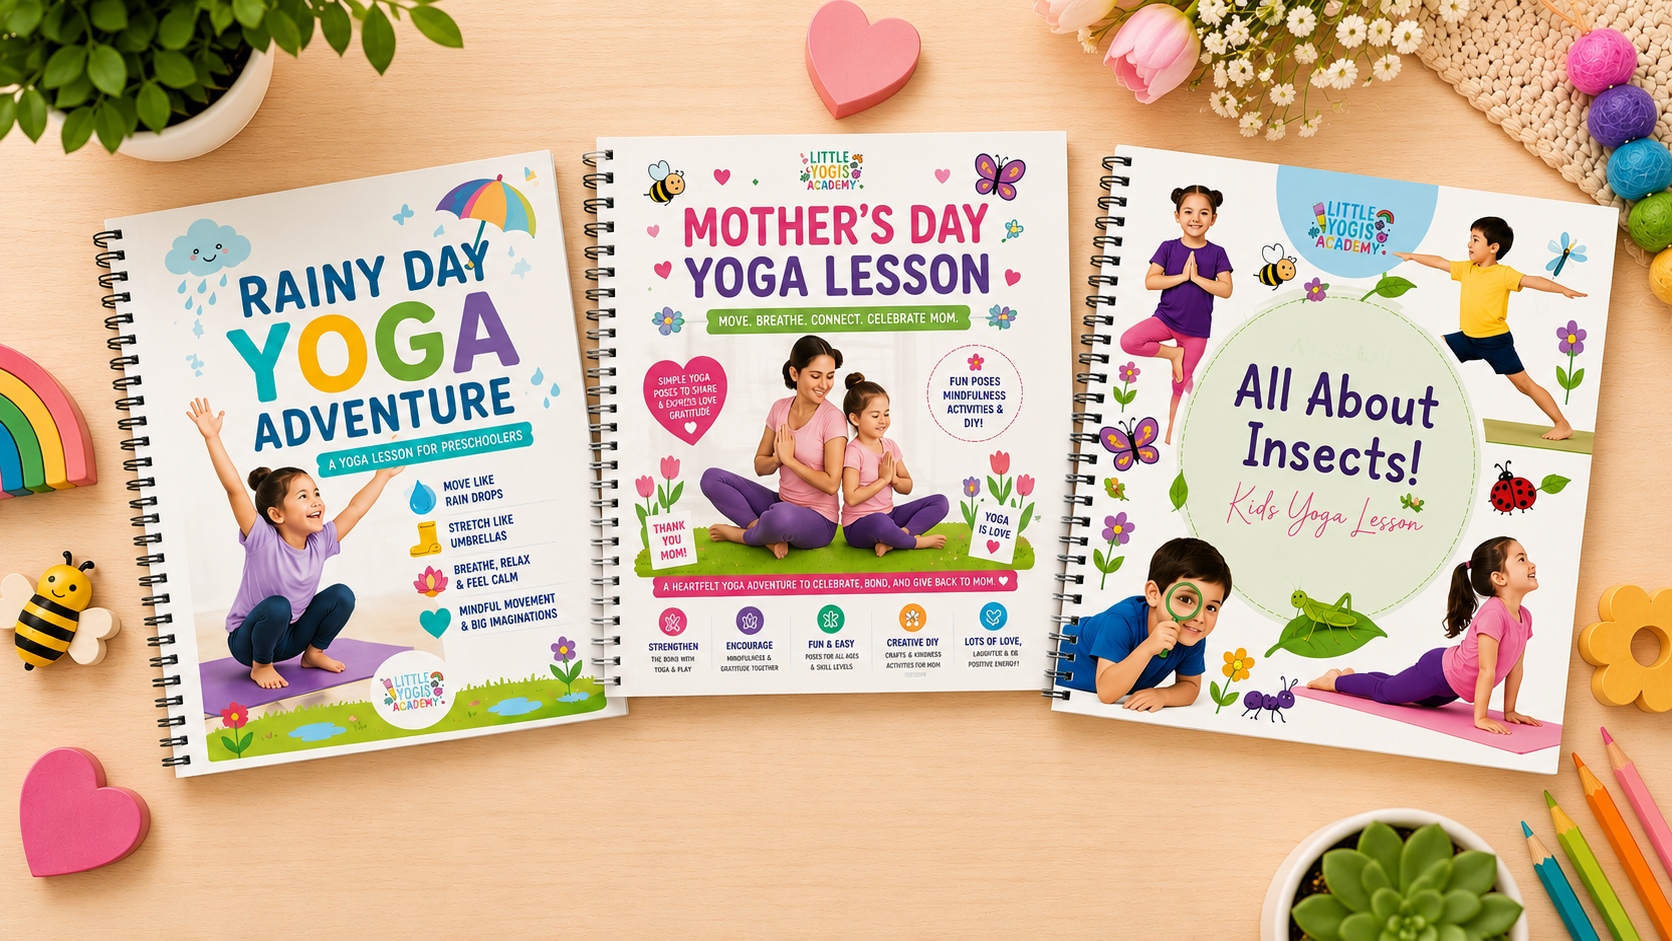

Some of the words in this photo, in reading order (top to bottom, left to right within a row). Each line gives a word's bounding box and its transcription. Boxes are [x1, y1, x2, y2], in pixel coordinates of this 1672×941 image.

[810, 151, 849, 164] LITTLE
[810, 164, 850, 179] YOGIS
[807, 179, 857, 190] ACADEMY
[1327, 200, 1376, 222] LITTLE
[684, 203, 894, 247] MOTHER'S
[911, 203, 988, 245] DAY
[1328, 217, 1374, 240] YOGIS
[1315, 235, 1380, 255] ACADEMY
[238, 255, 386, 318] RAINY
[404, 240, 489, 292] DAY
[684, 255, 808, 298] YOGA
[826, 253, 990, 297] LESSON
[718, 315, 752, 327] MOVE.
[756, 315, 808, 326] BREATHE.
[811, 314, 863, 326] CONNECT.
[867, 312, 926, 325] CELEBRATE
[930, 312, 959, 324] MOM.
[226, 291, 521, 403] YOGA
[658, 375, 686, 386] SIMPLE
[689, 373, 711, 383] YOGA
[949, 376, 968, 386] FUN
[971, 376, 1001, 386] POSES
[653, 387, 678, 398] POSES
[680, 386, 690, 396] TO
[692, 384, 718, 395] SHARE
[943, 390, 1006, 400] MINDFULNESS
[1233, 363, 1292, 413] All
[1305, 371, 1440, 430] About
[699, 396, 718, 406] LOVE
[254, 377, 516, 452] ADVENTURE
[669, 406, 711, 420] GRATITUDE
[947, 404, 994, 414] ACTIVITIES
[996, 404, 1004, 414] &
[964, 418, 983, 428] DIY!
[328, 459, 336, 471] A
[339, 454, 369, 469] YOGA
[371, 447, 414, 464] LESSON
[417, 443, 438, 457] FOR
[441, 429, 523, 453] PRESCHOOLERS
[1242, 421, 1422, 487] Insects!
[443, 478, 471, 492] MOVE
[473, 474, 495, 487] LIKE
[445, 493, 469, 507] RAIN
[471, 488, 503, 503] DROPS
[1226, 481, 1280, 525] Kids
[1287, 490, 1347, 539] Yoga
[1350, 497, 1424, 538] Lesson
[448, 517, 491, 533] STRETCH
[493, 514, 514, 527] LIKE
[985, 511, 1009, 526] YOGA
[653, 520, 686, 534] THANK
[978, 524, 988, 535] IS
[988, 527, 1012, 539] LOVE
[450, 530, 508, 549] UMBRELLAS
[662, 534, 681, 546] YOU
[660, 547, 687, 561] MOM!
[454, 559, 499, 575] BREATHE,
[500, 554, 531, 568] RELAX
[456, 579, 465, 590] &
[466, 576, 489, 588] FEEL
[491, 571, 519, 585] CALM
[663, 582, 670, 592] A
[672, 581, 719, 591] HEARTFELT
[721, 581, 745, 591] YOGA
[747, 580, 797, 590] ADVENTURE
[799, 579, 811, 589] TO
[812, 578, 863, 590] CELEBRATE,
[864, 578, 891, 589] BOND,
[892, 577, 910, 587] AND
[913, 577, 933, 587] GIVE
[935, 577, 958, 587] BACK
[960, 577, 971, 586] TO
[973, 576, 996, 586] MOM.
[459, 601, 502, 616] MINDFUL
[504, 593, 556, 610] MOVEMENT
[461, 621, 469, 632] &
[471, 618, 487, 630] BIG
[490, 608, 558, 627] IMAGINATIONS
[648, 642, 699, 651] STRENGTHEN
[726, 641, 773, 650] ENCOURAGE
[808, 640, 824, 649] FUN
[826, 640, 833, 649] &
[835, 639, 855, 648] EASY
[886, 638, 923, 647] CREATIVE
[926, 638, 939, 646] DIY
[964, 637, 985, 646] LOTS
[986, 637, 997, 646] OF
[1000, 637, 1022, 647] LOVE,
[394, 672, 430, 688] LITTLE
[396, 684, 431, 701] YOGIS
[393, 698, 439, 712] ACADEMY
